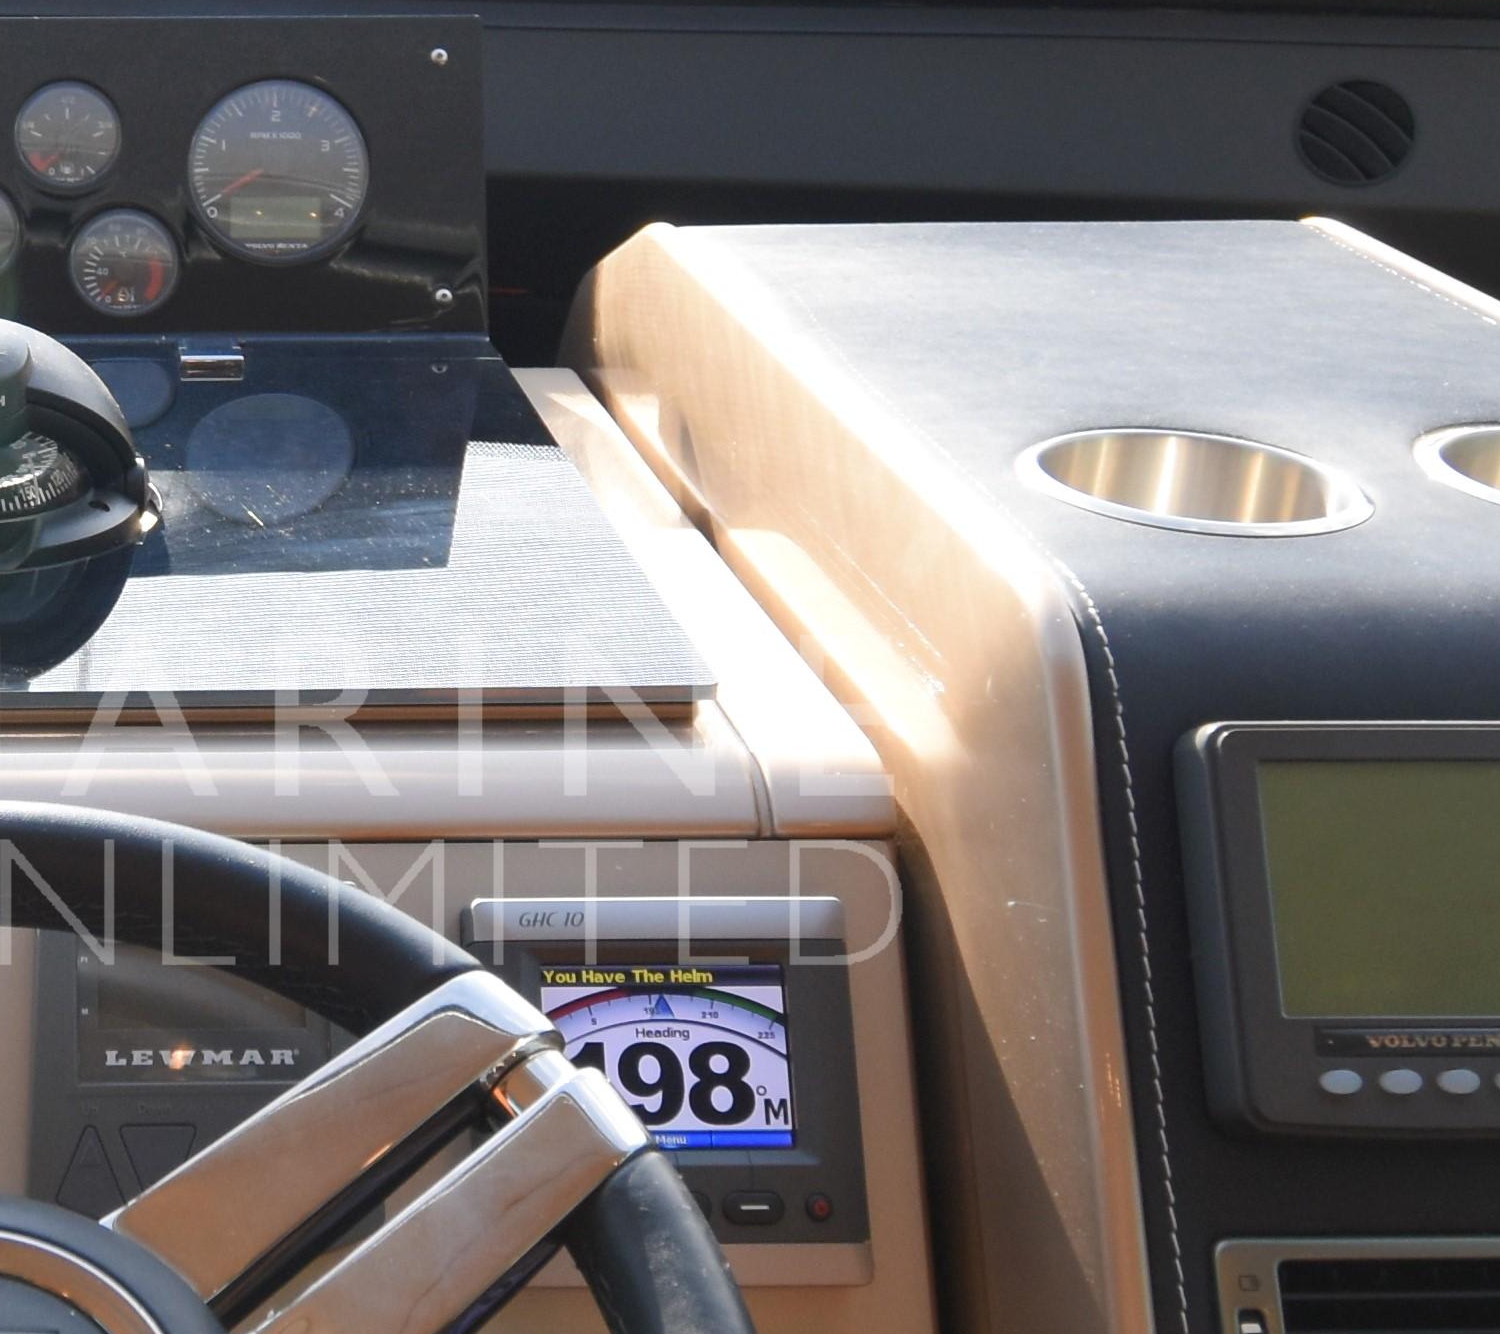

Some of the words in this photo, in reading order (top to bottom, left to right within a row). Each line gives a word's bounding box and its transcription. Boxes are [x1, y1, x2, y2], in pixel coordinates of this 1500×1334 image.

[272, 110, 281, 122] 2
[321, 140, 330, 152] 3
[519, 912, 558, 928] GHC
[543, 970, 577, 984] You
[582, 970, 626, 984] Have
[631, 969, 664, 984] The
[670, 969, 713, 983] Helm
[635, 1027, 690, 1041] Heading
[1366, 1033, 1449, 1049] VOLVO
[104, 1049, 297, 1067] LEWMAR
[655, 1134, 687, 1144] Menu
